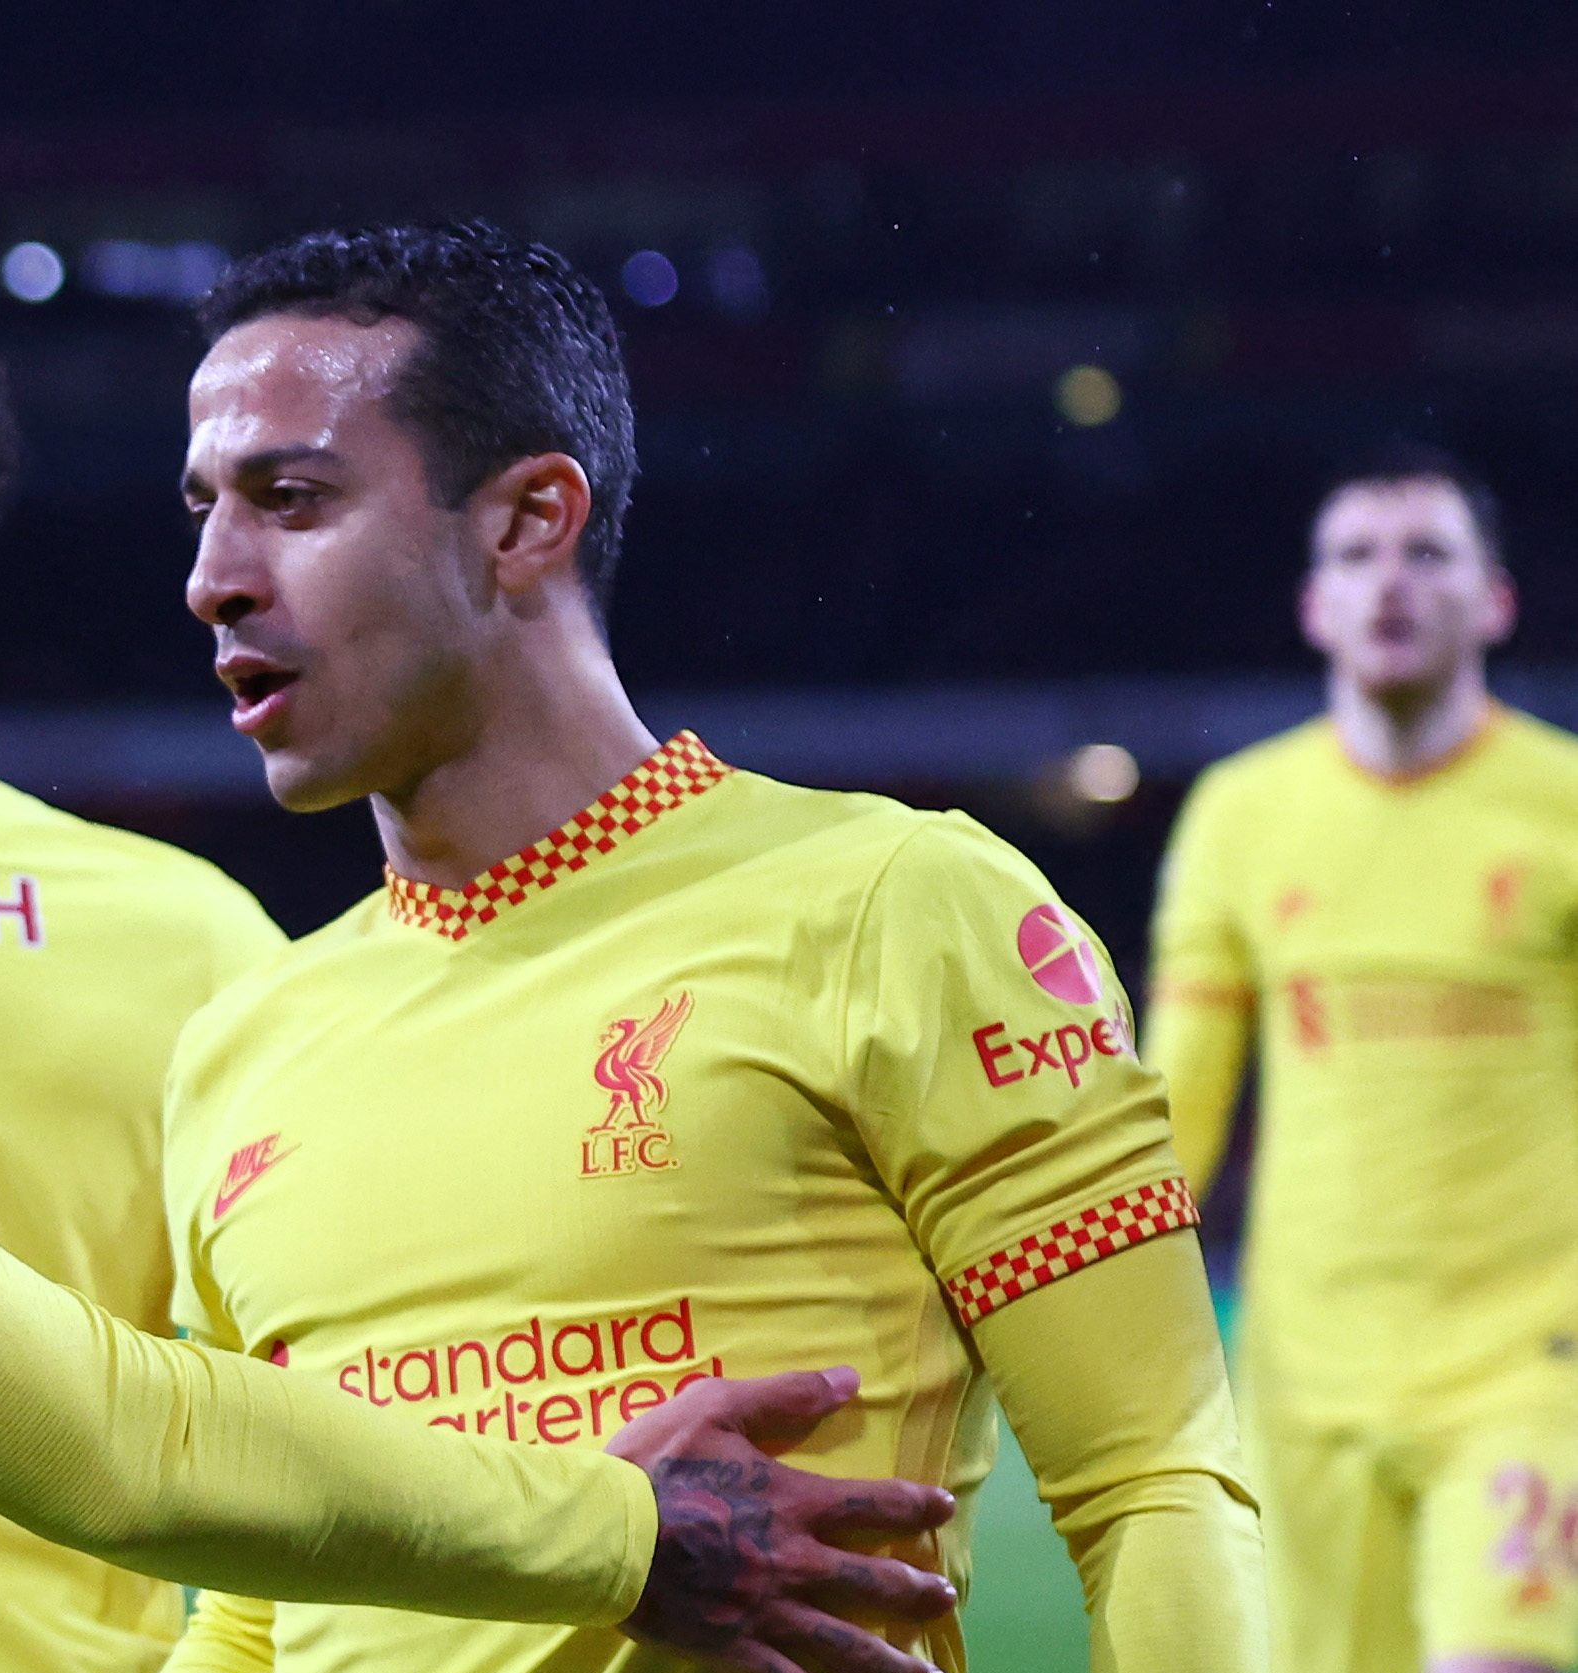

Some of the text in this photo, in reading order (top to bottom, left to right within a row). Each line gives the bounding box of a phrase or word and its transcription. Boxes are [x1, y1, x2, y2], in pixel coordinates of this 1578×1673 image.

[972, 998, 1138, 1090] Expe
[339, 1297, 697, 1408] standard
[1485, 1460, 1578, 1574] 2
